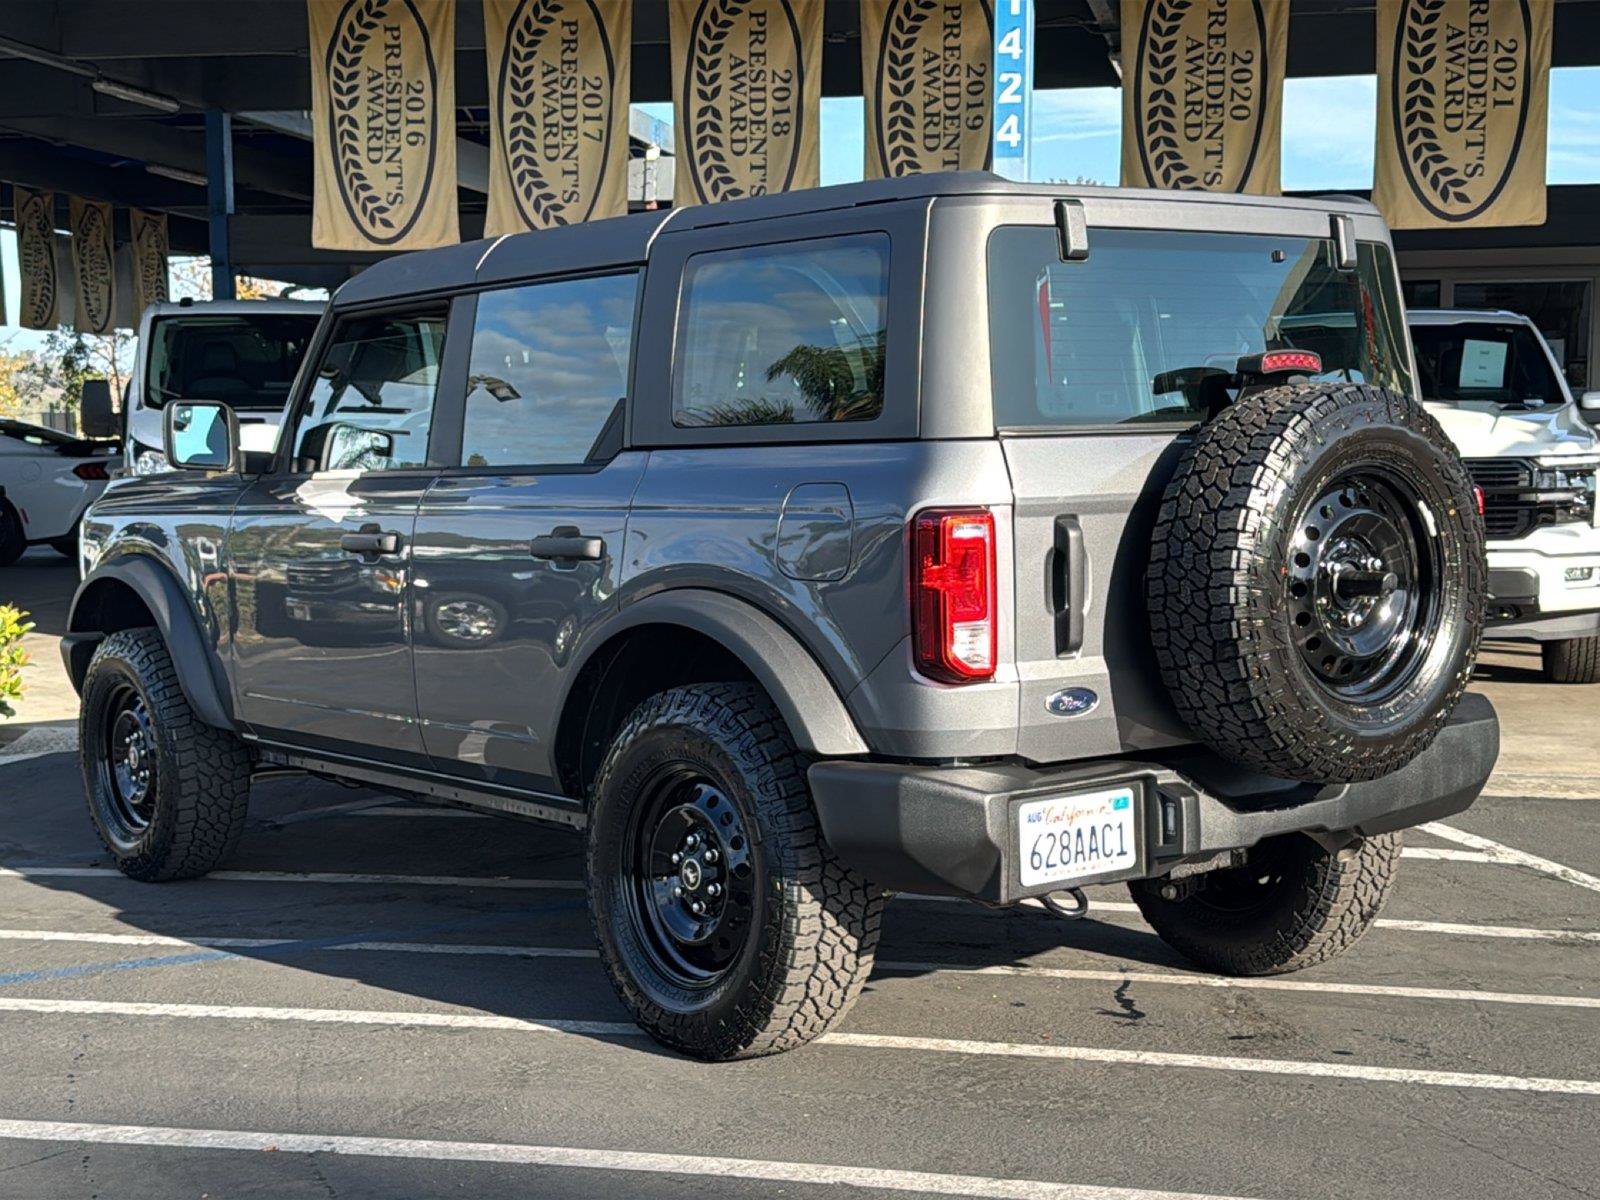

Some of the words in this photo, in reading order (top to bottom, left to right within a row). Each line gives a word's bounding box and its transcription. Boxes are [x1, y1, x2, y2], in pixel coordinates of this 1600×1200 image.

[366, 66, 384, 165] AWARD
[384, 24, 404, 206] PRESIDENT'S
[405, 79, 426, 147] 2016
[542, 61, 561, 162] AWARD
[560, 19, 579, 204] PRESIDENT'S
[582, 76, 603, 142] 2017
[729, 53, 748, 157] AWARD
[749, 9, 768, 197] PRESIDENT'S
[771, 69, 793, 137] 2018
[923, 47, 941, 152] AWARD
[942, 4, 961, 171] PRESIDENT
[965, 62, 987, 131] 2019
[1184, 36, 1204, 143] AWARD
[1229, 50, 1254, 122] 2020
[1444, 23, 1465, 133] AWARD
[1464, 0, 1490, 179] RESIDENT'S
[1492, 38, 1518, 109] 2021
[1030, 821, 1128, 871] 628AAC1
